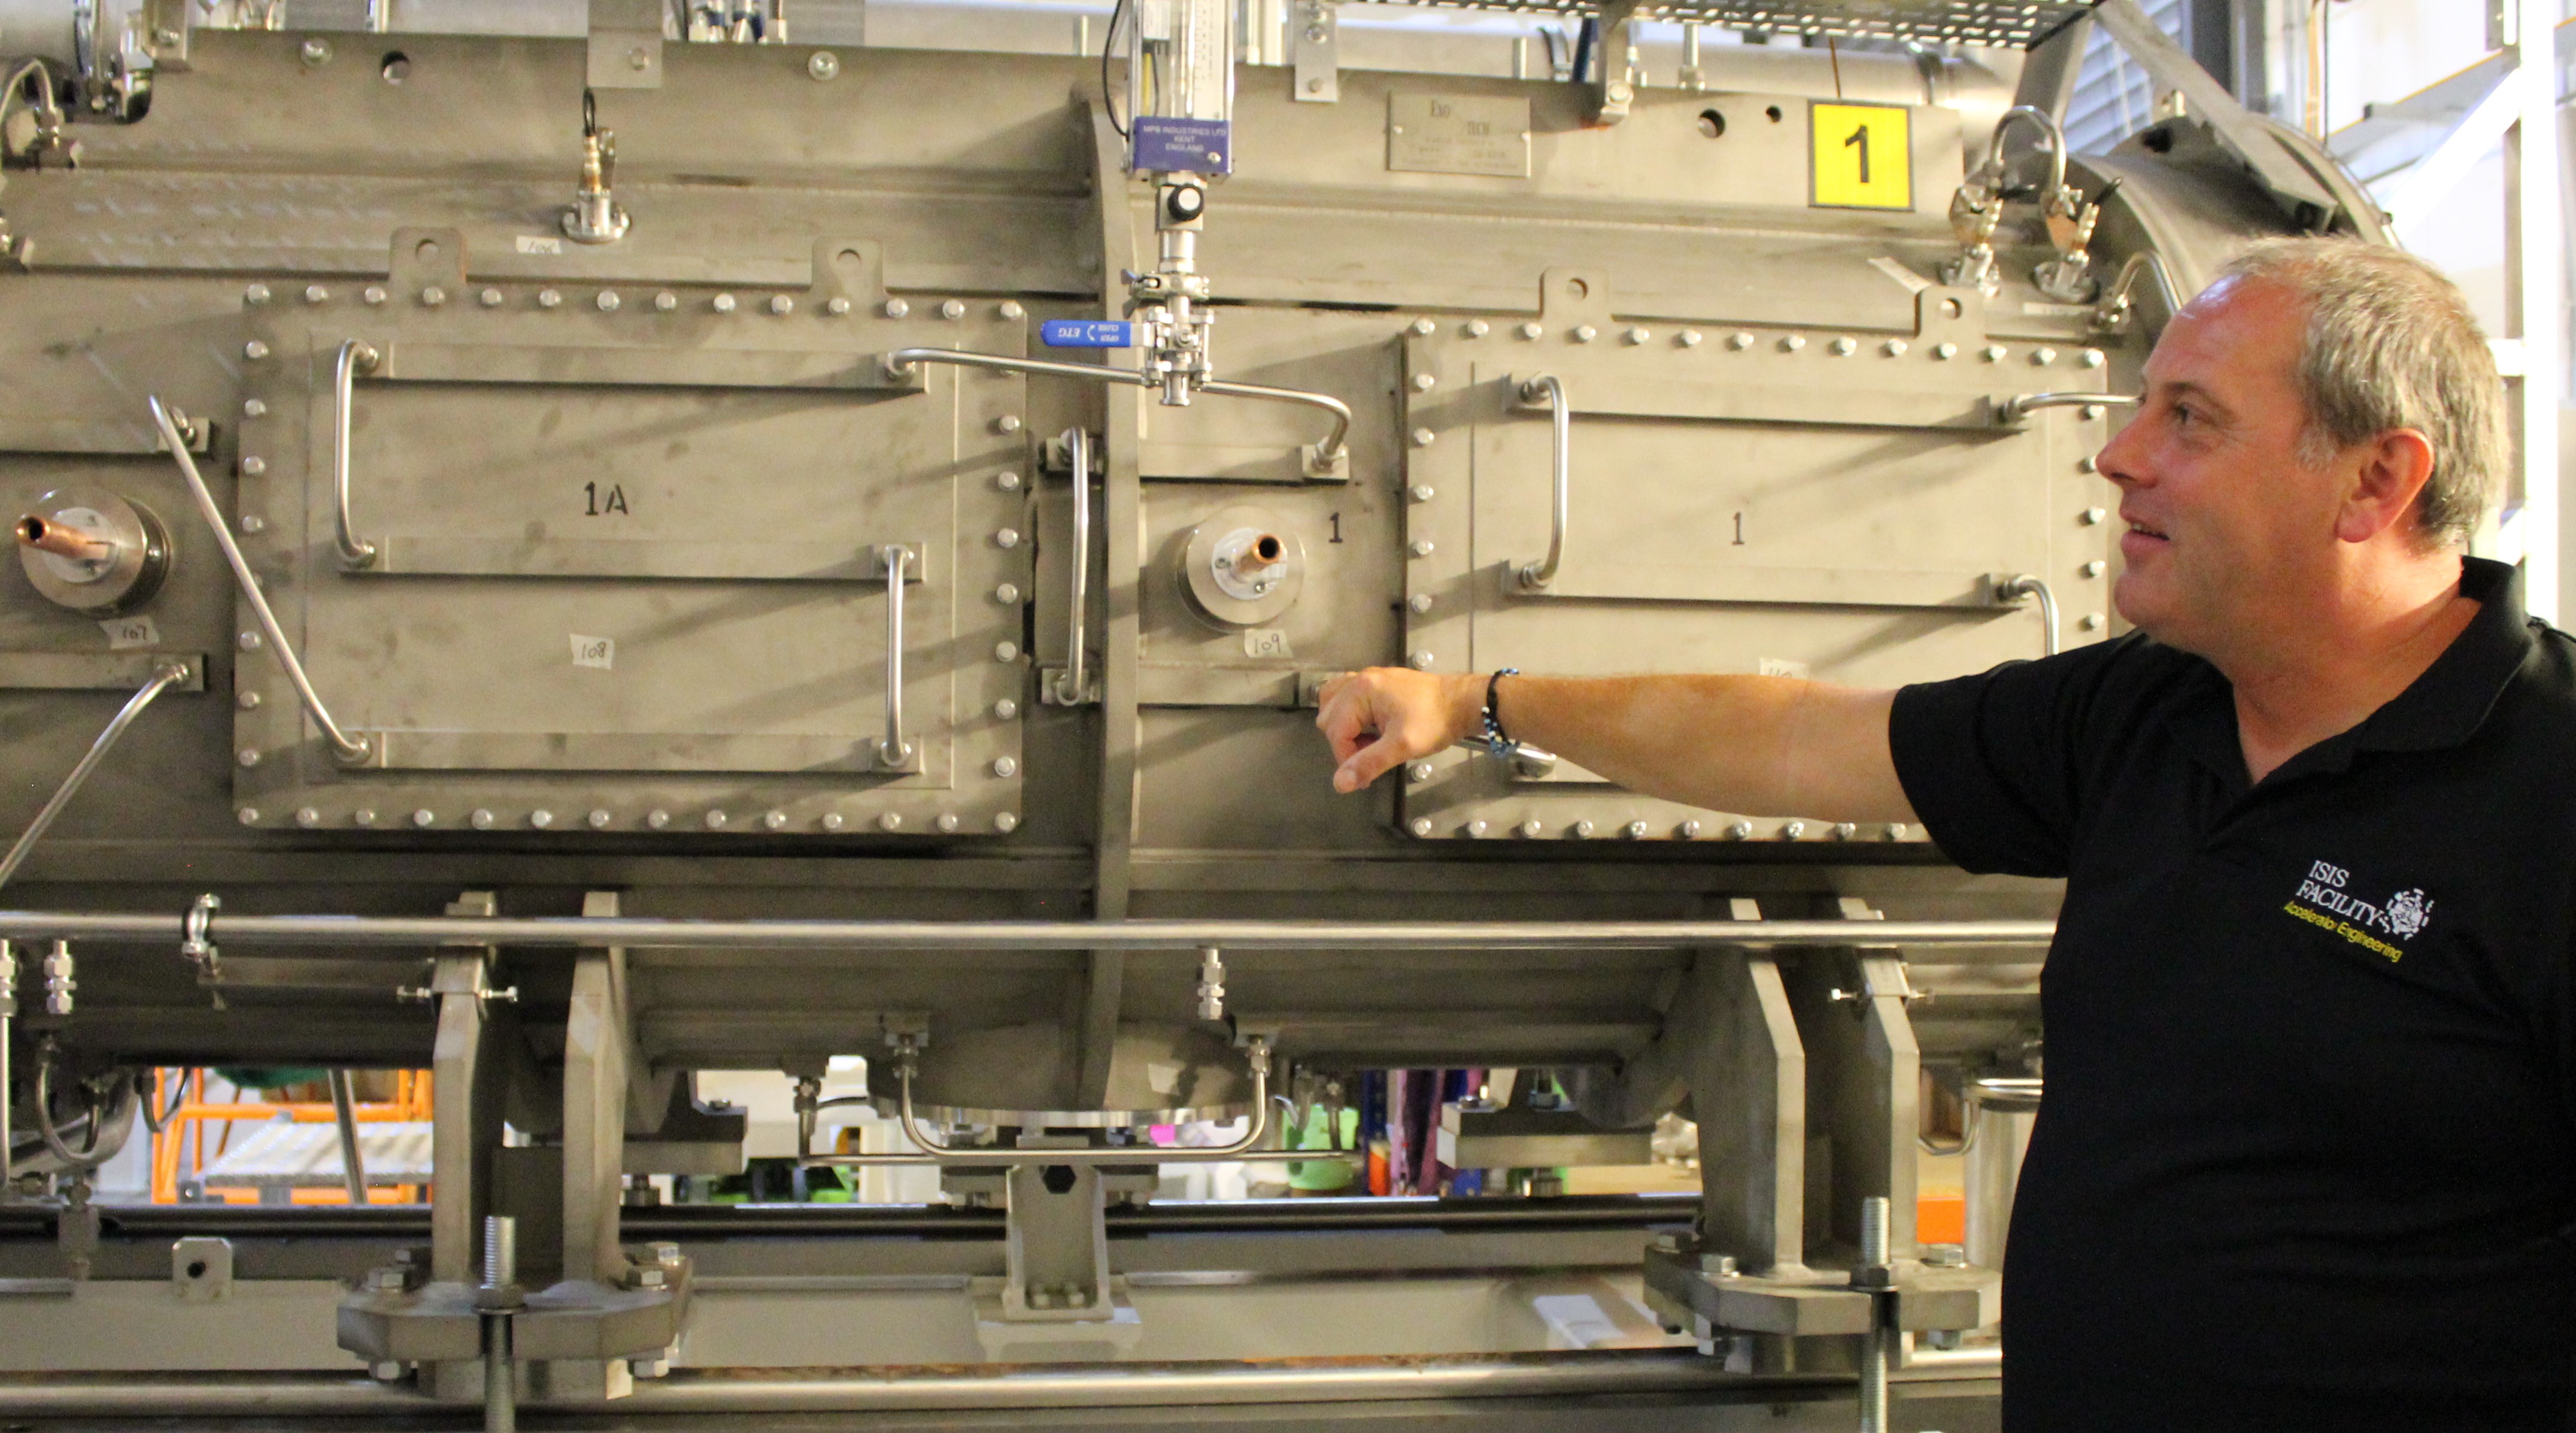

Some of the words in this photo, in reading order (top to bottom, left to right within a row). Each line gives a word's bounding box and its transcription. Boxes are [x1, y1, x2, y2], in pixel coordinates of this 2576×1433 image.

[1845, 124, 1869, 183] 1
[1058, 327, 1081, 338] ETG
[584, 481, 628, 516] 1A
[1329, 512, 1343, 543] 1
[1732, 511, 1744, 546] 1
[123, 624, 146, 641] 107
[1254, 634, 1281, 654] 109
[581, 641, 606, 660] 108
[2308, 860, 2350, 887] ISIS
[2296, 880, 2384, 926] FACILITY
